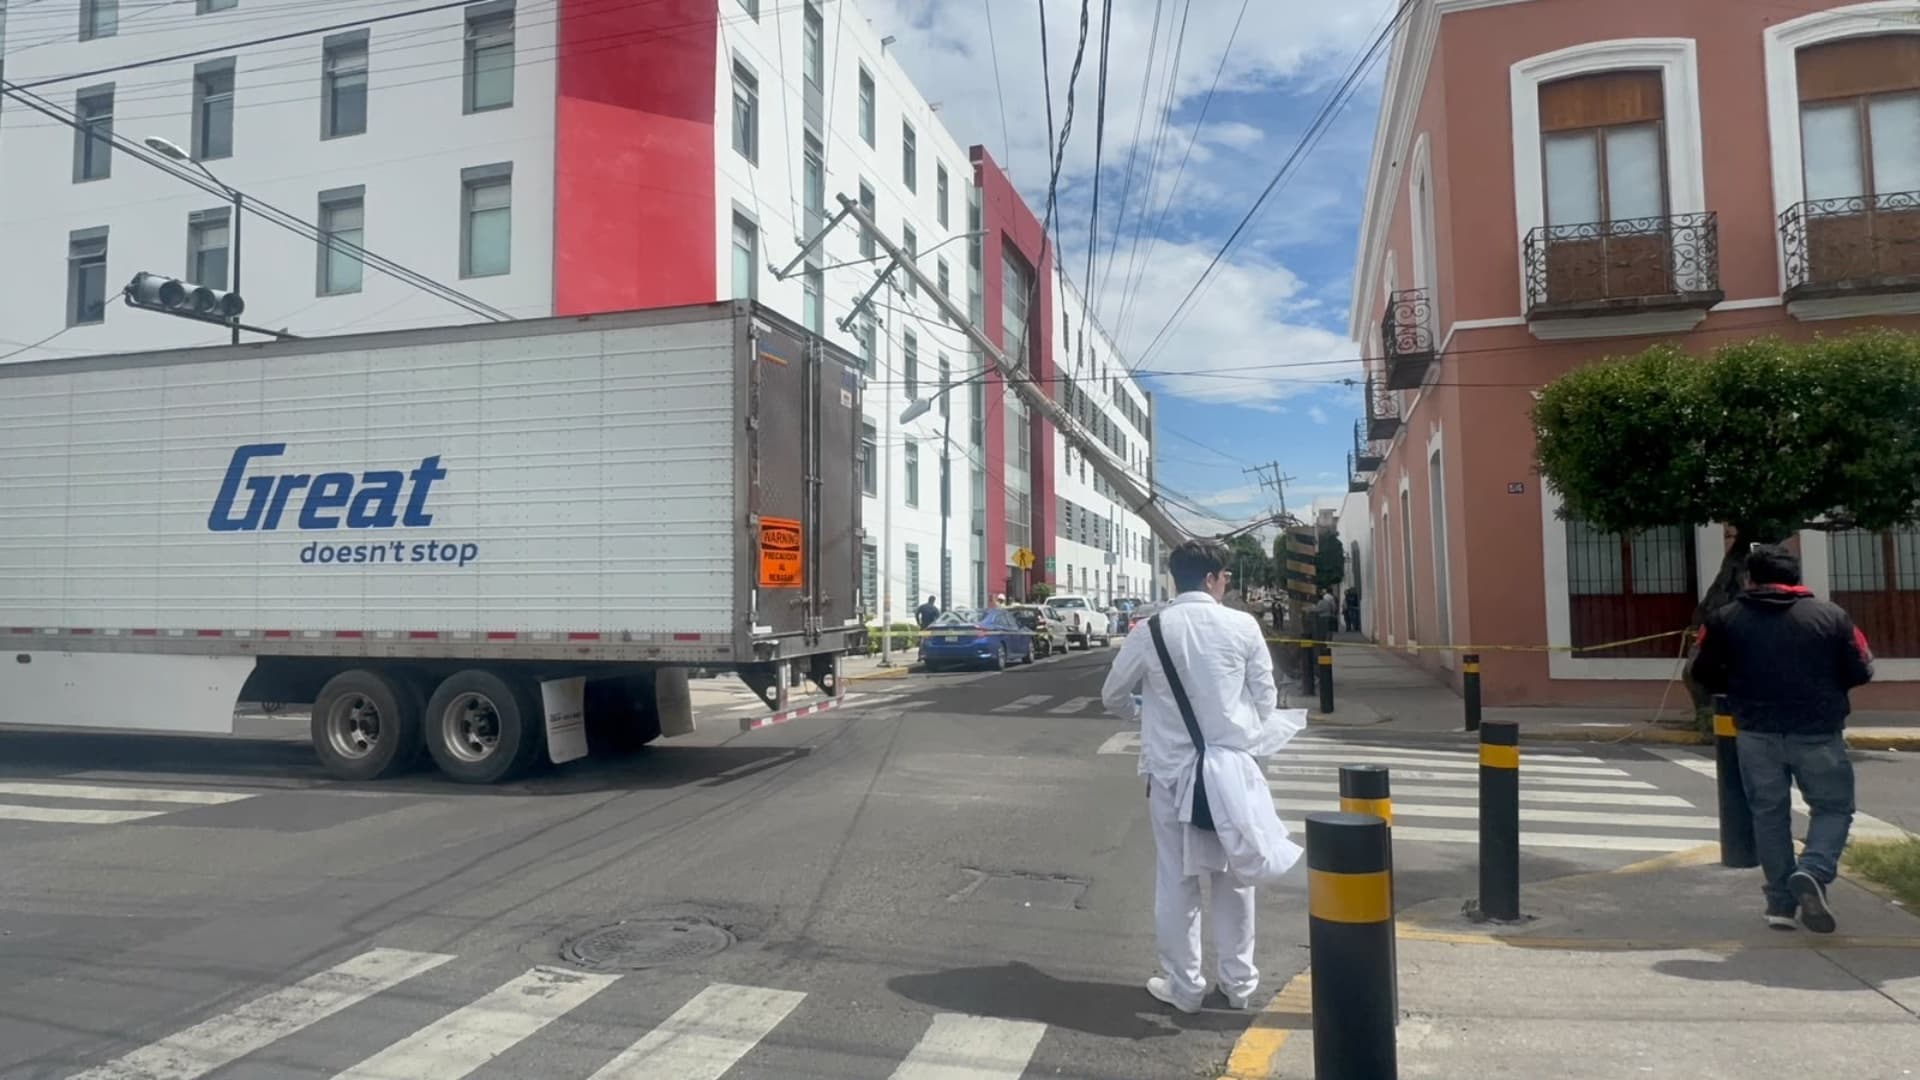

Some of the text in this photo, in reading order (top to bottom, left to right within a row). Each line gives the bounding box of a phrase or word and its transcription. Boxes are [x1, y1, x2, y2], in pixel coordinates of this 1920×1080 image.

[208, 443, 447, 531] Great
[764, 531, 800, 545] WARNING
[300, 540, 479, 567] doesn't stop
